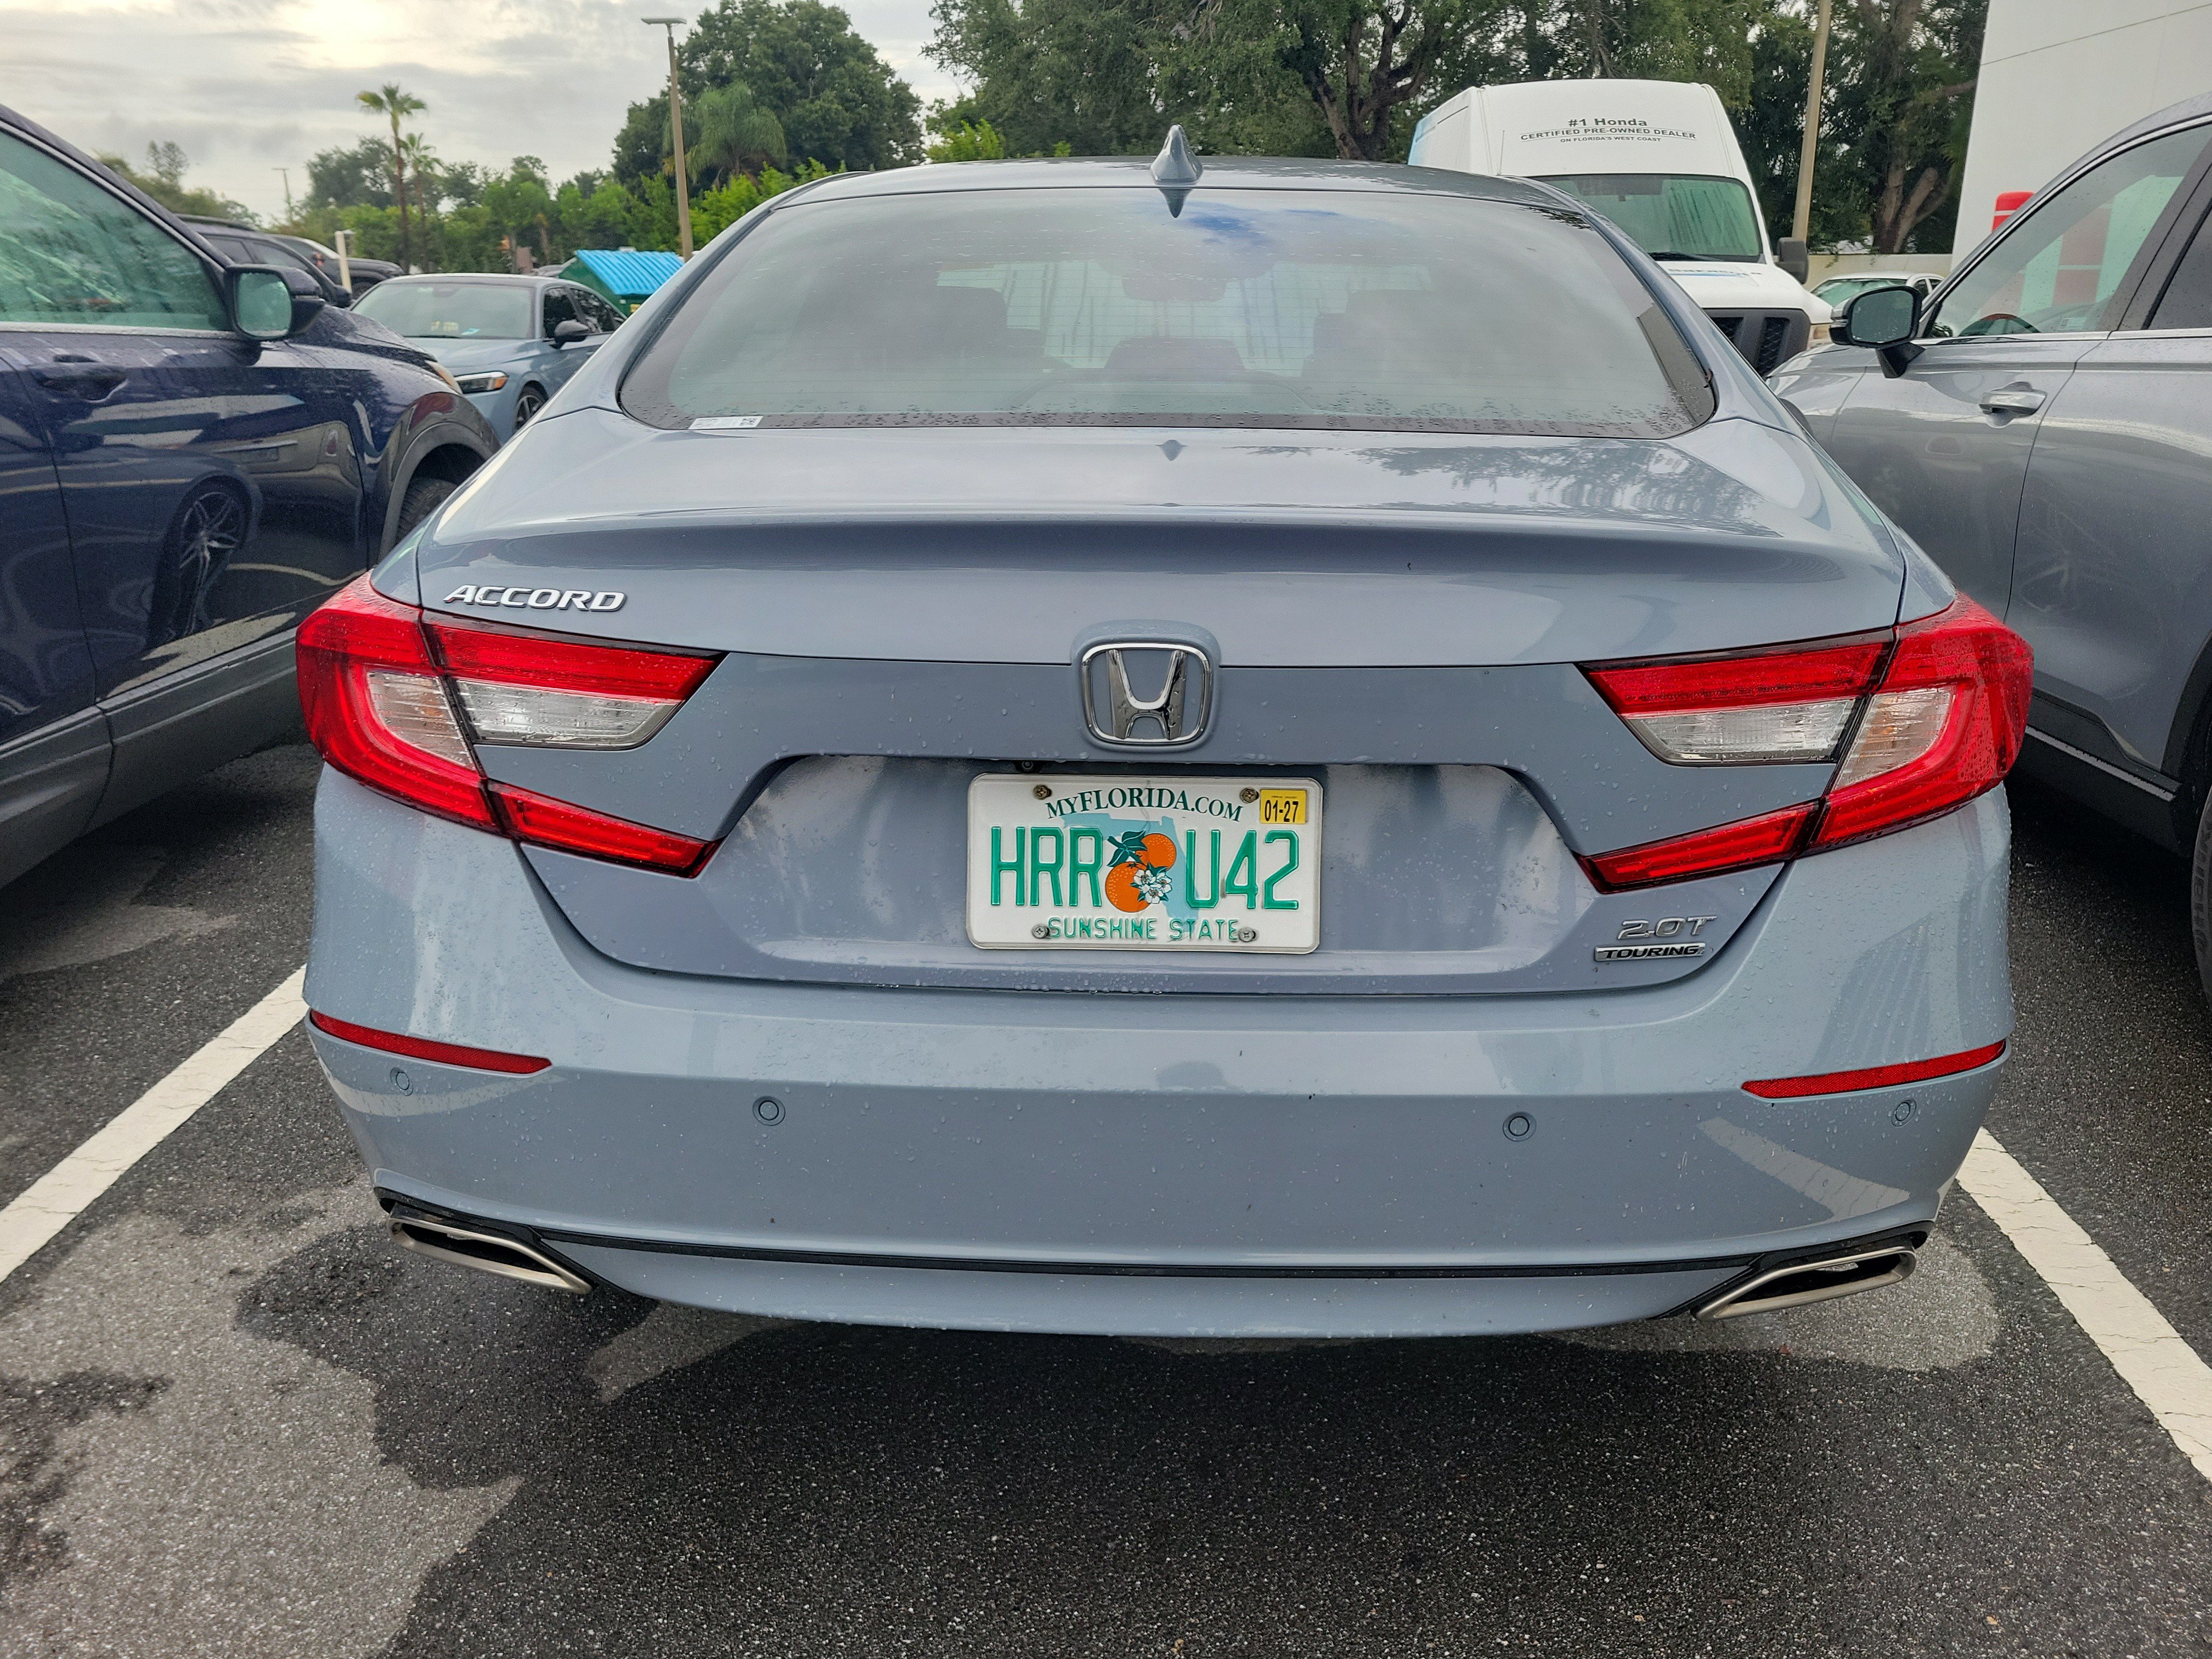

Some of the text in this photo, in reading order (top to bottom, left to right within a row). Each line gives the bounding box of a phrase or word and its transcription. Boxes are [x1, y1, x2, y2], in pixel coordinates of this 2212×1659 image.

[1521, 128, 1581, 140] CERTIFIED
[1654, 129, 1697, 139] DEALER
[1568, 117, 1648, 127] #1 Honda
[443, 584, 628, 612] ACCORD
[1045, 787, 1244, 822] MYFLORIDA.COM
[1265, 799, 1299, 823] 01-27
[990, 826, 1299, 911] HRR U42
[1048, 917, 1239, 941] SUNSHINE STATE
[1617, 914, 1718, 940] 2.0T
[1604, 945, 1700, 960] TOURING
